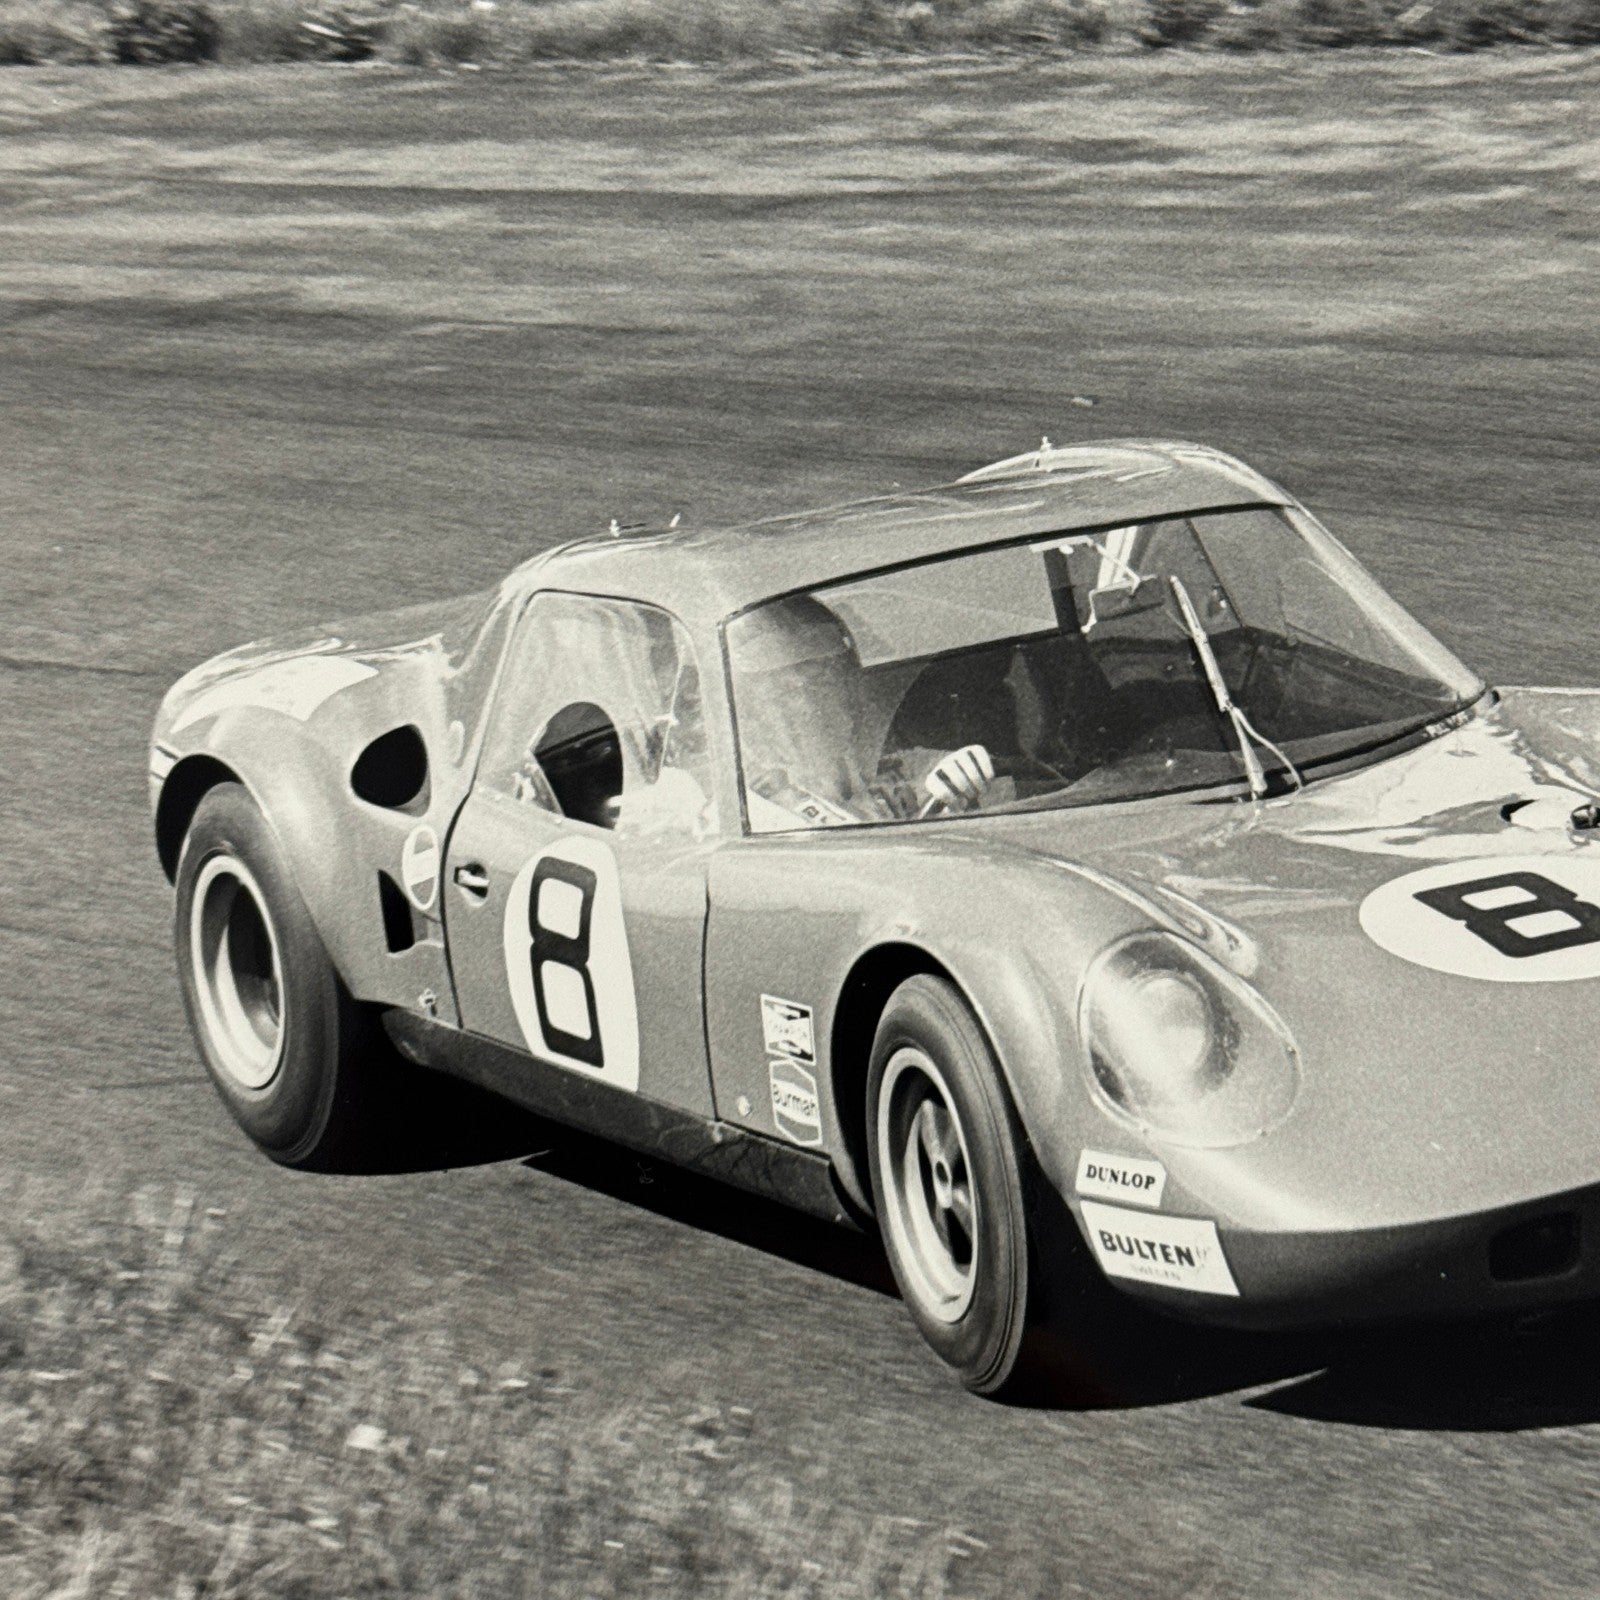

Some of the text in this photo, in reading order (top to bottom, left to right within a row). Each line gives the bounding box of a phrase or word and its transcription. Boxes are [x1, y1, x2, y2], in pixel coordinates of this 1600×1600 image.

[1412, 871, 1600, 958] 8
[529, 856, 604, 1068] 8
[1086, 1164, 1156, 1190] DUNLOP
[1098, 1229, 1195, 1267] BULTEN
